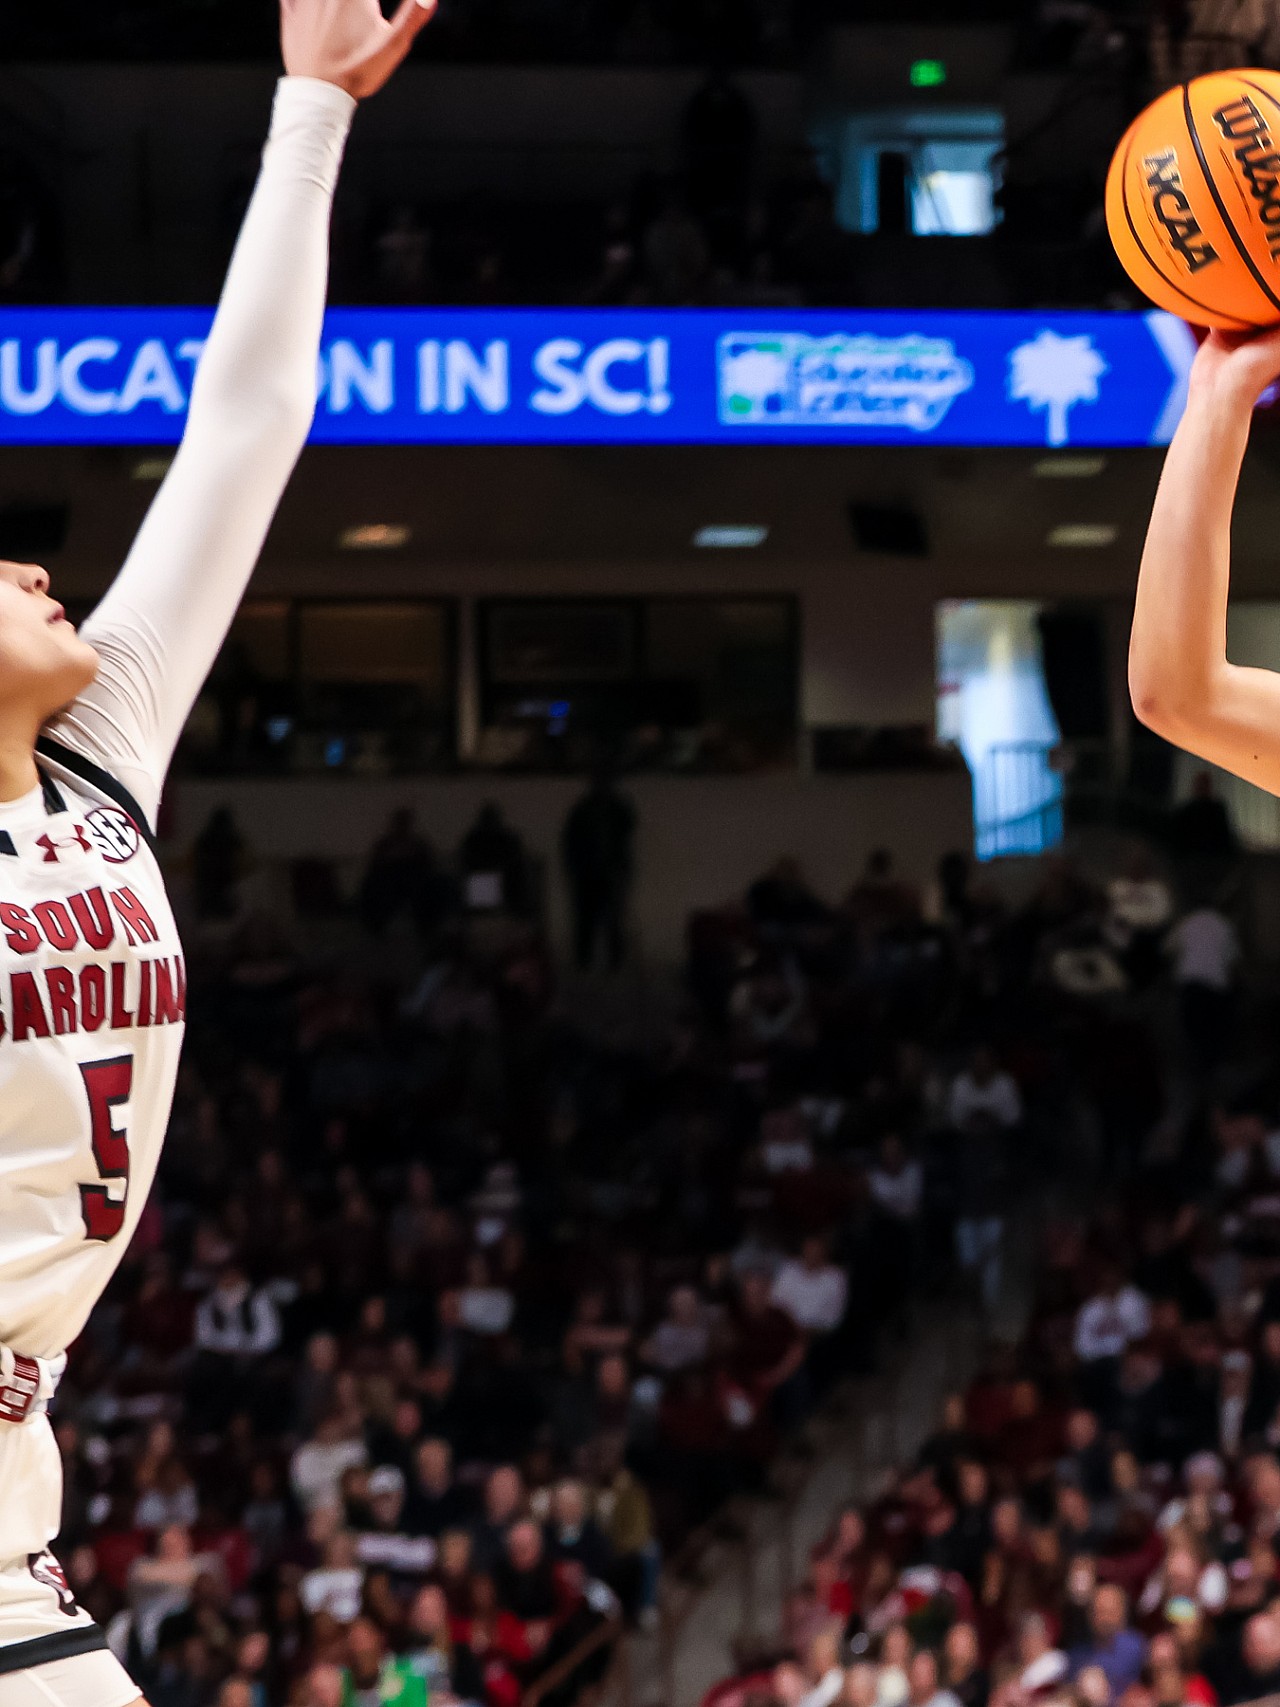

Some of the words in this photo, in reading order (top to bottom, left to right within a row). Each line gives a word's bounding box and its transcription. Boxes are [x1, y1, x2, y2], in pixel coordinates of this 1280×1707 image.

[1142, 144, 1221, 275] NCAA
[418, 339, 509, 413] IN
[531, 337, 671, 414] SC!
[78, 1054, 134, 1242] 5
